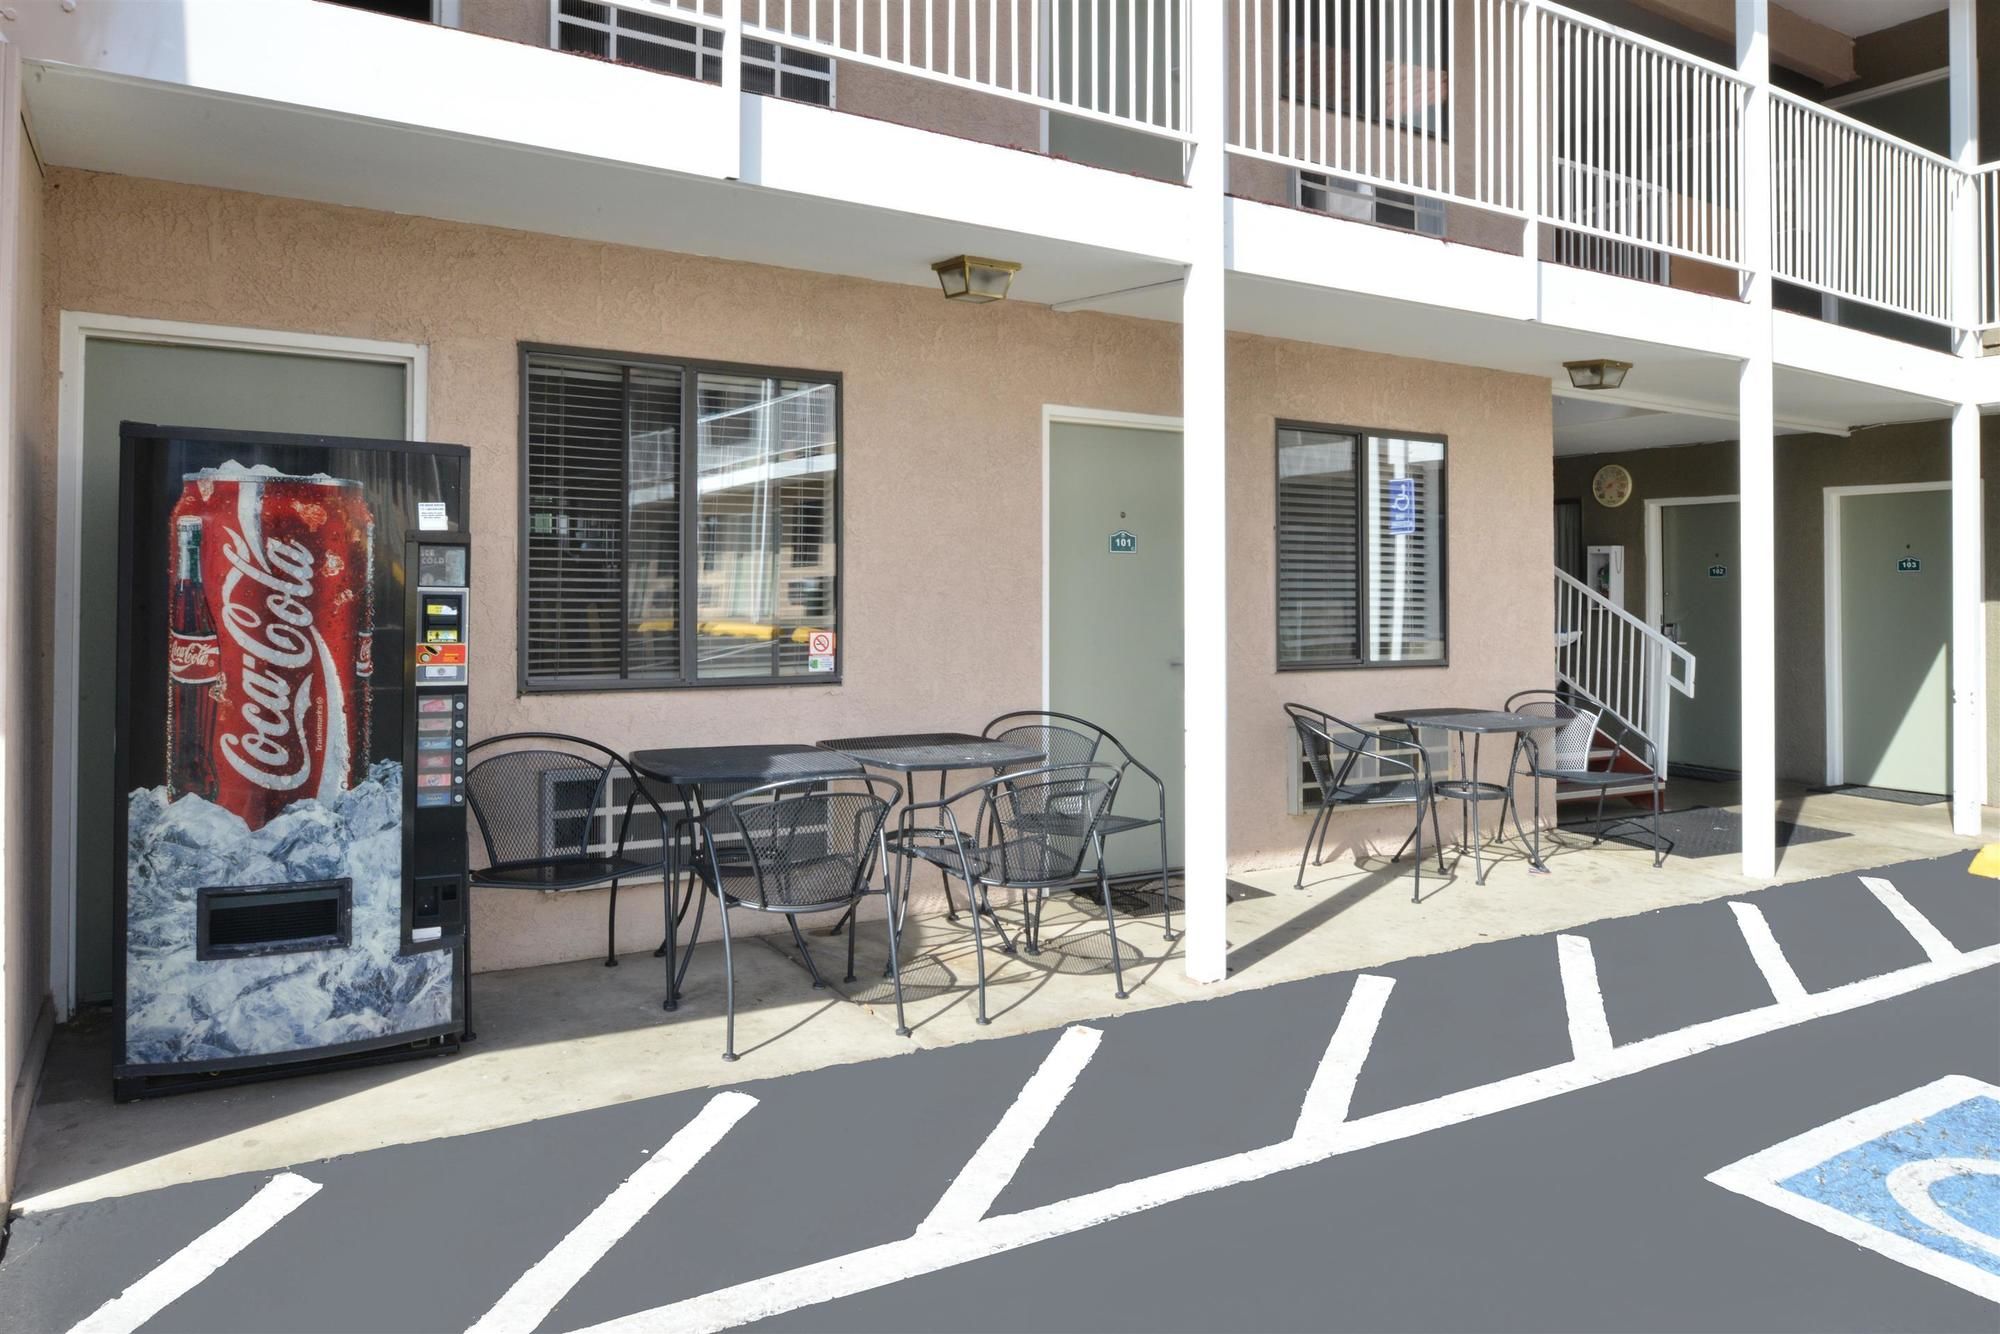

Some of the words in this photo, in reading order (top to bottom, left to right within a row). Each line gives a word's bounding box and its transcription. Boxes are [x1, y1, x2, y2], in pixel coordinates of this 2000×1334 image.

[1115, 538, 1132, 547] 101
[1902, 561, 1917, 569] 103
[220, 525, 314, 791] Coca-Cola
